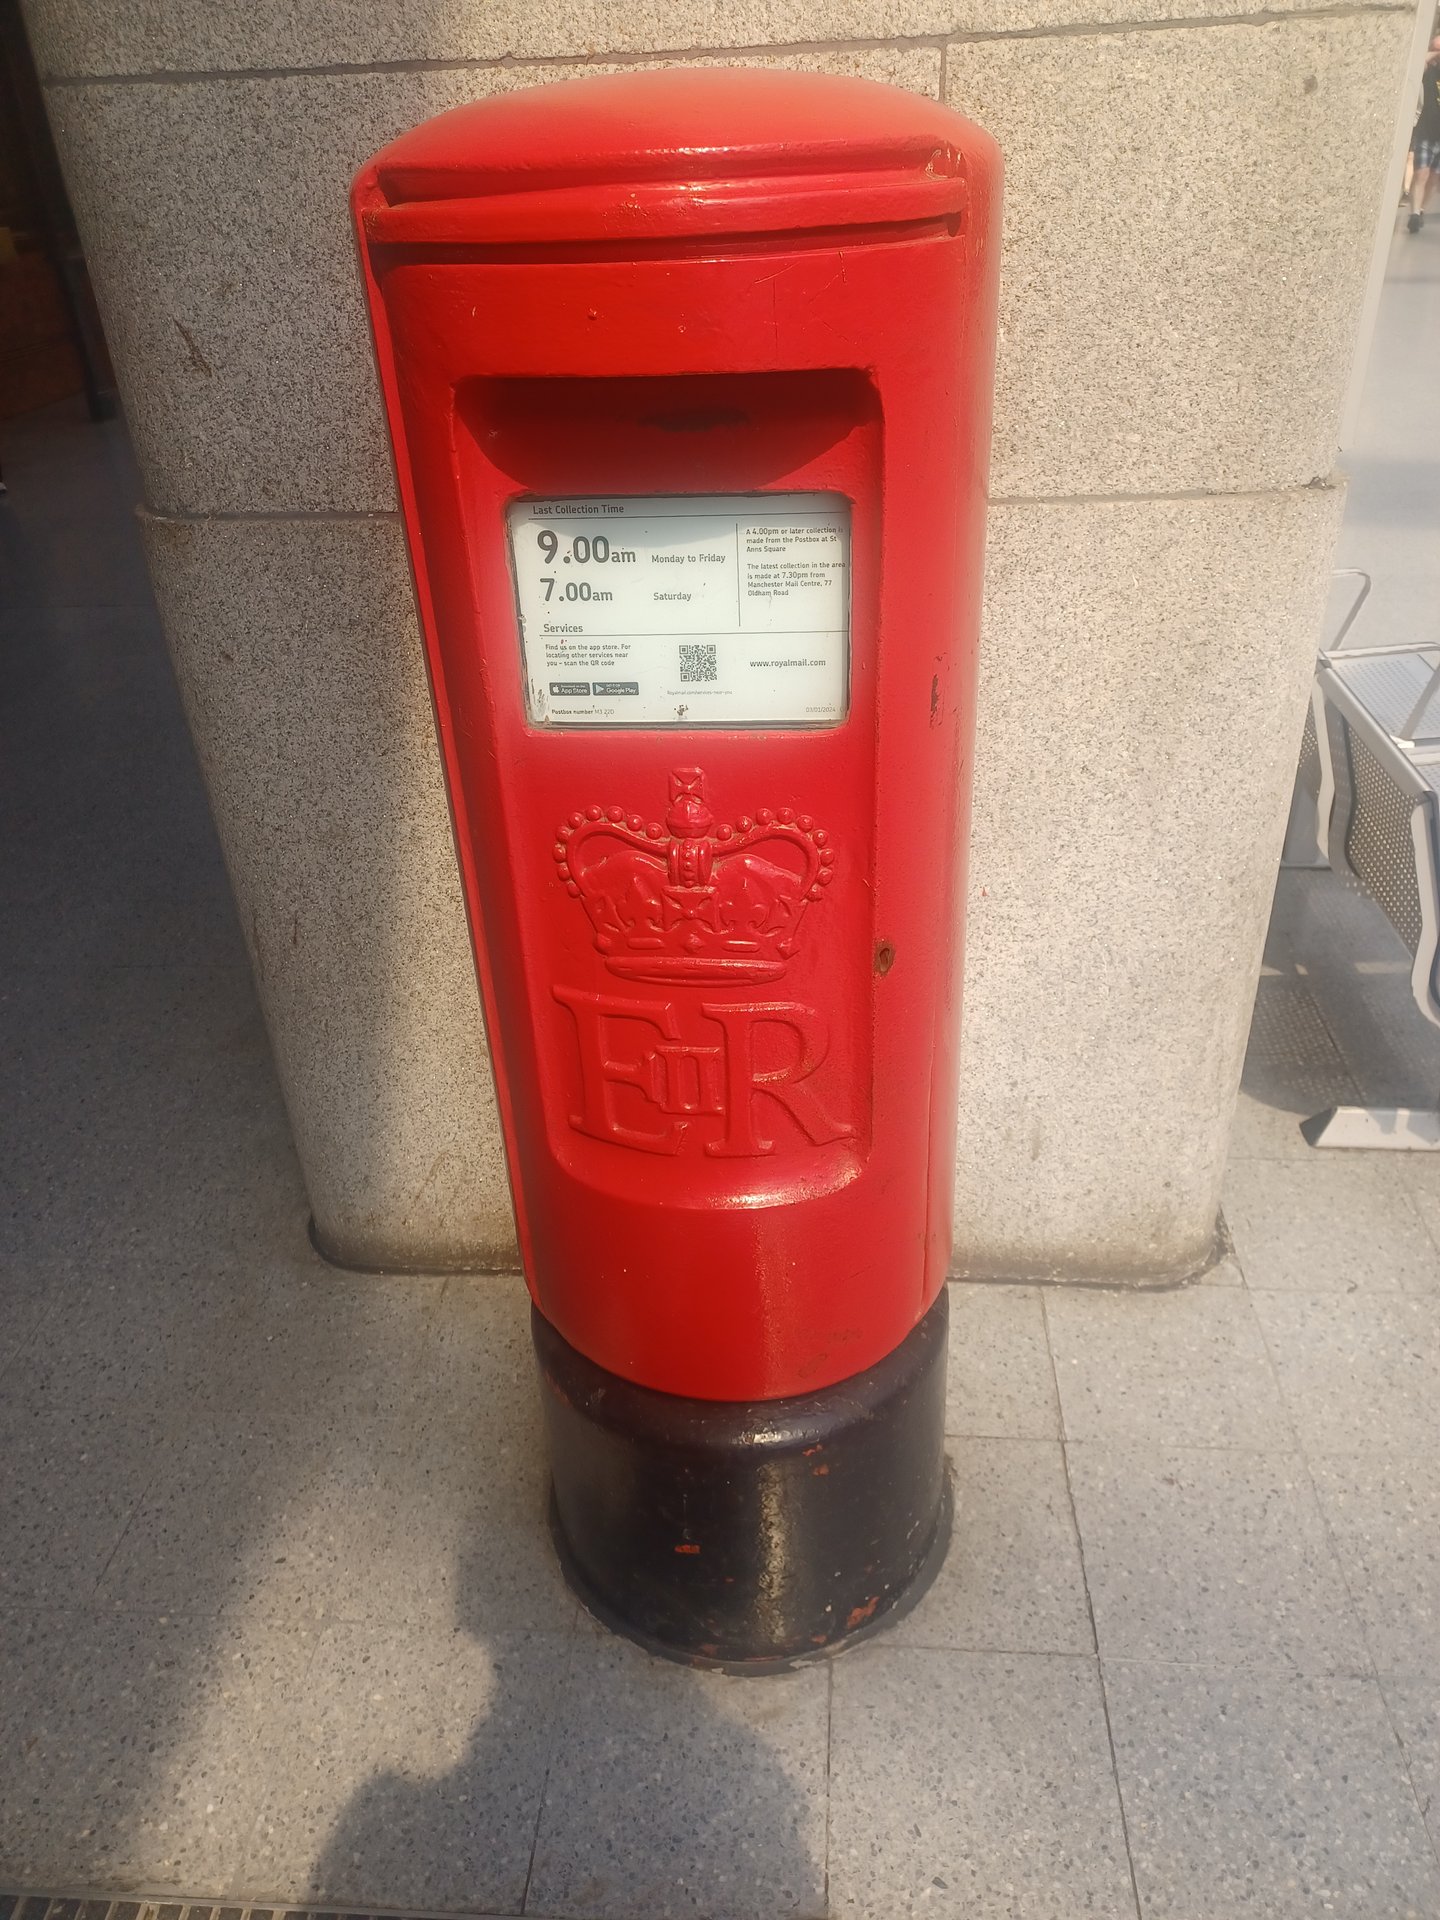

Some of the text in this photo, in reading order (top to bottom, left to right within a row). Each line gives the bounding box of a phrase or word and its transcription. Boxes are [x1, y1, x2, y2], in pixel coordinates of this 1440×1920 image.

[533, 505, 624, 515] Last Collection Time
[752, 527, 779, 536] 4.00pm
[537, 530, 636, 564] 9.00am
[652, 553, 726, 565] Monday to Friday
[781, 571, 809, 580] 7.30pm
[540, 578, 613, 602] 7.00am
[654, 592, 692, 601] Saturday
[543, 623, 584, 633] Services
[545, 652, 570, 660] locating
[750, 659, 826, 668] www.royalmail.com
